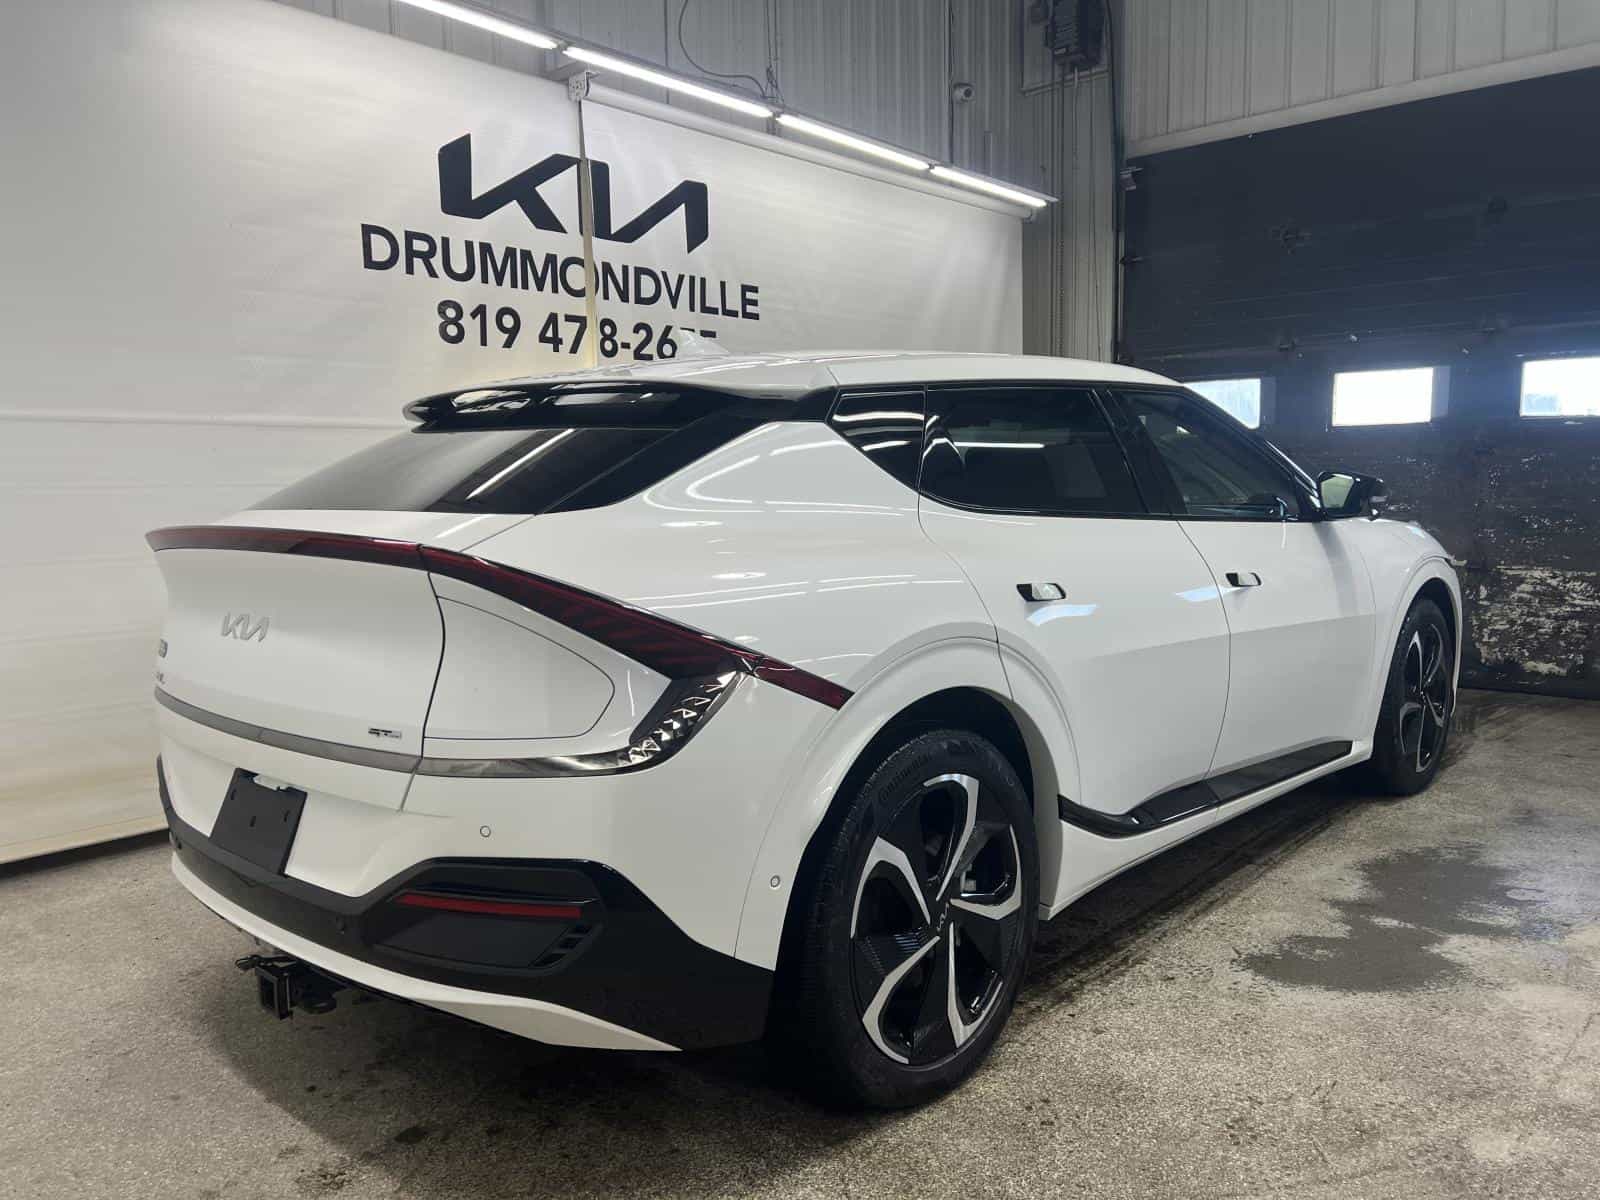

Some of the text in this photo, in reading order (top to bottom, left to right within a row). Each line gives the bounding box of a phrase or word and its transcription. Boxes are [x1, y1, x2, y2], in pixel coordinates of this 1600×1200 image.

[438, 133, 709, 254] KIA
[360, 223, 760, 320] DRUMMONDVILLE
[437, 299, 717, 361] 819 478-26
[220, 611, 270, 642] KIA
